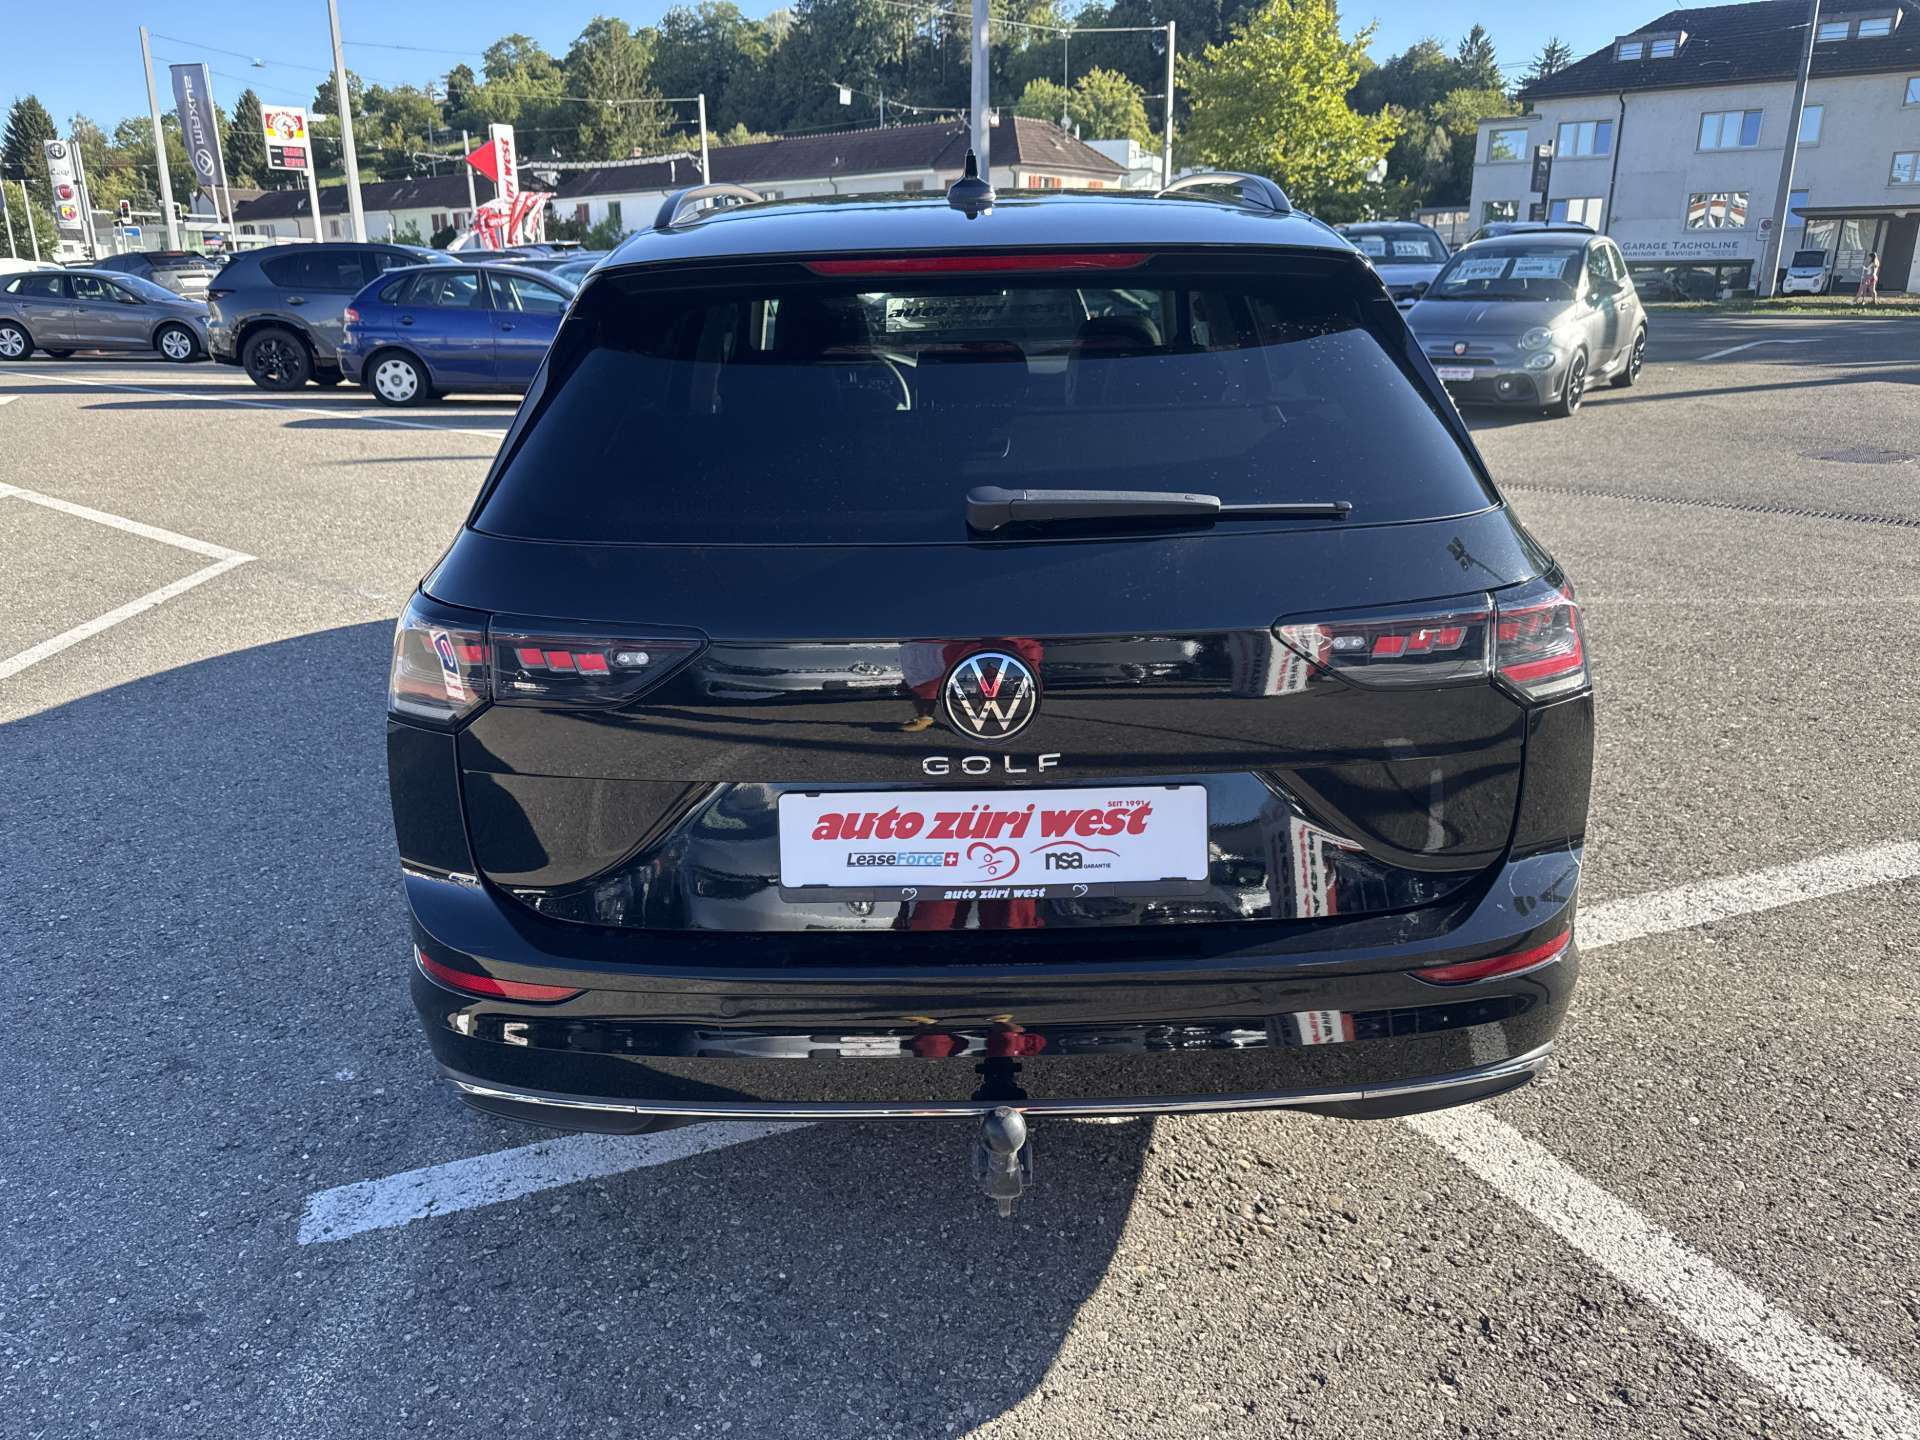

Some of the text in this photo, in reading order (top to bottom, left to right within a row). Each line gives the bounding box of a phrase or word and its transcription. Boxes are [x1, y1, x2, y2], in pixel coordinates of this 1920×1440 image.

[1622, 241, 1740, 250] GARAGE TACHOLINE
[922, 752, 1061, 775] GOLF
[1125, 799, 1145, 807] 1991
[811, 800, 1154, 841] auto züri west
[847, 852, 944, 866] LeaseForce
[1045, 851, 1083, 870] nsa
[943, 887, 1046, 900] auto züri west
